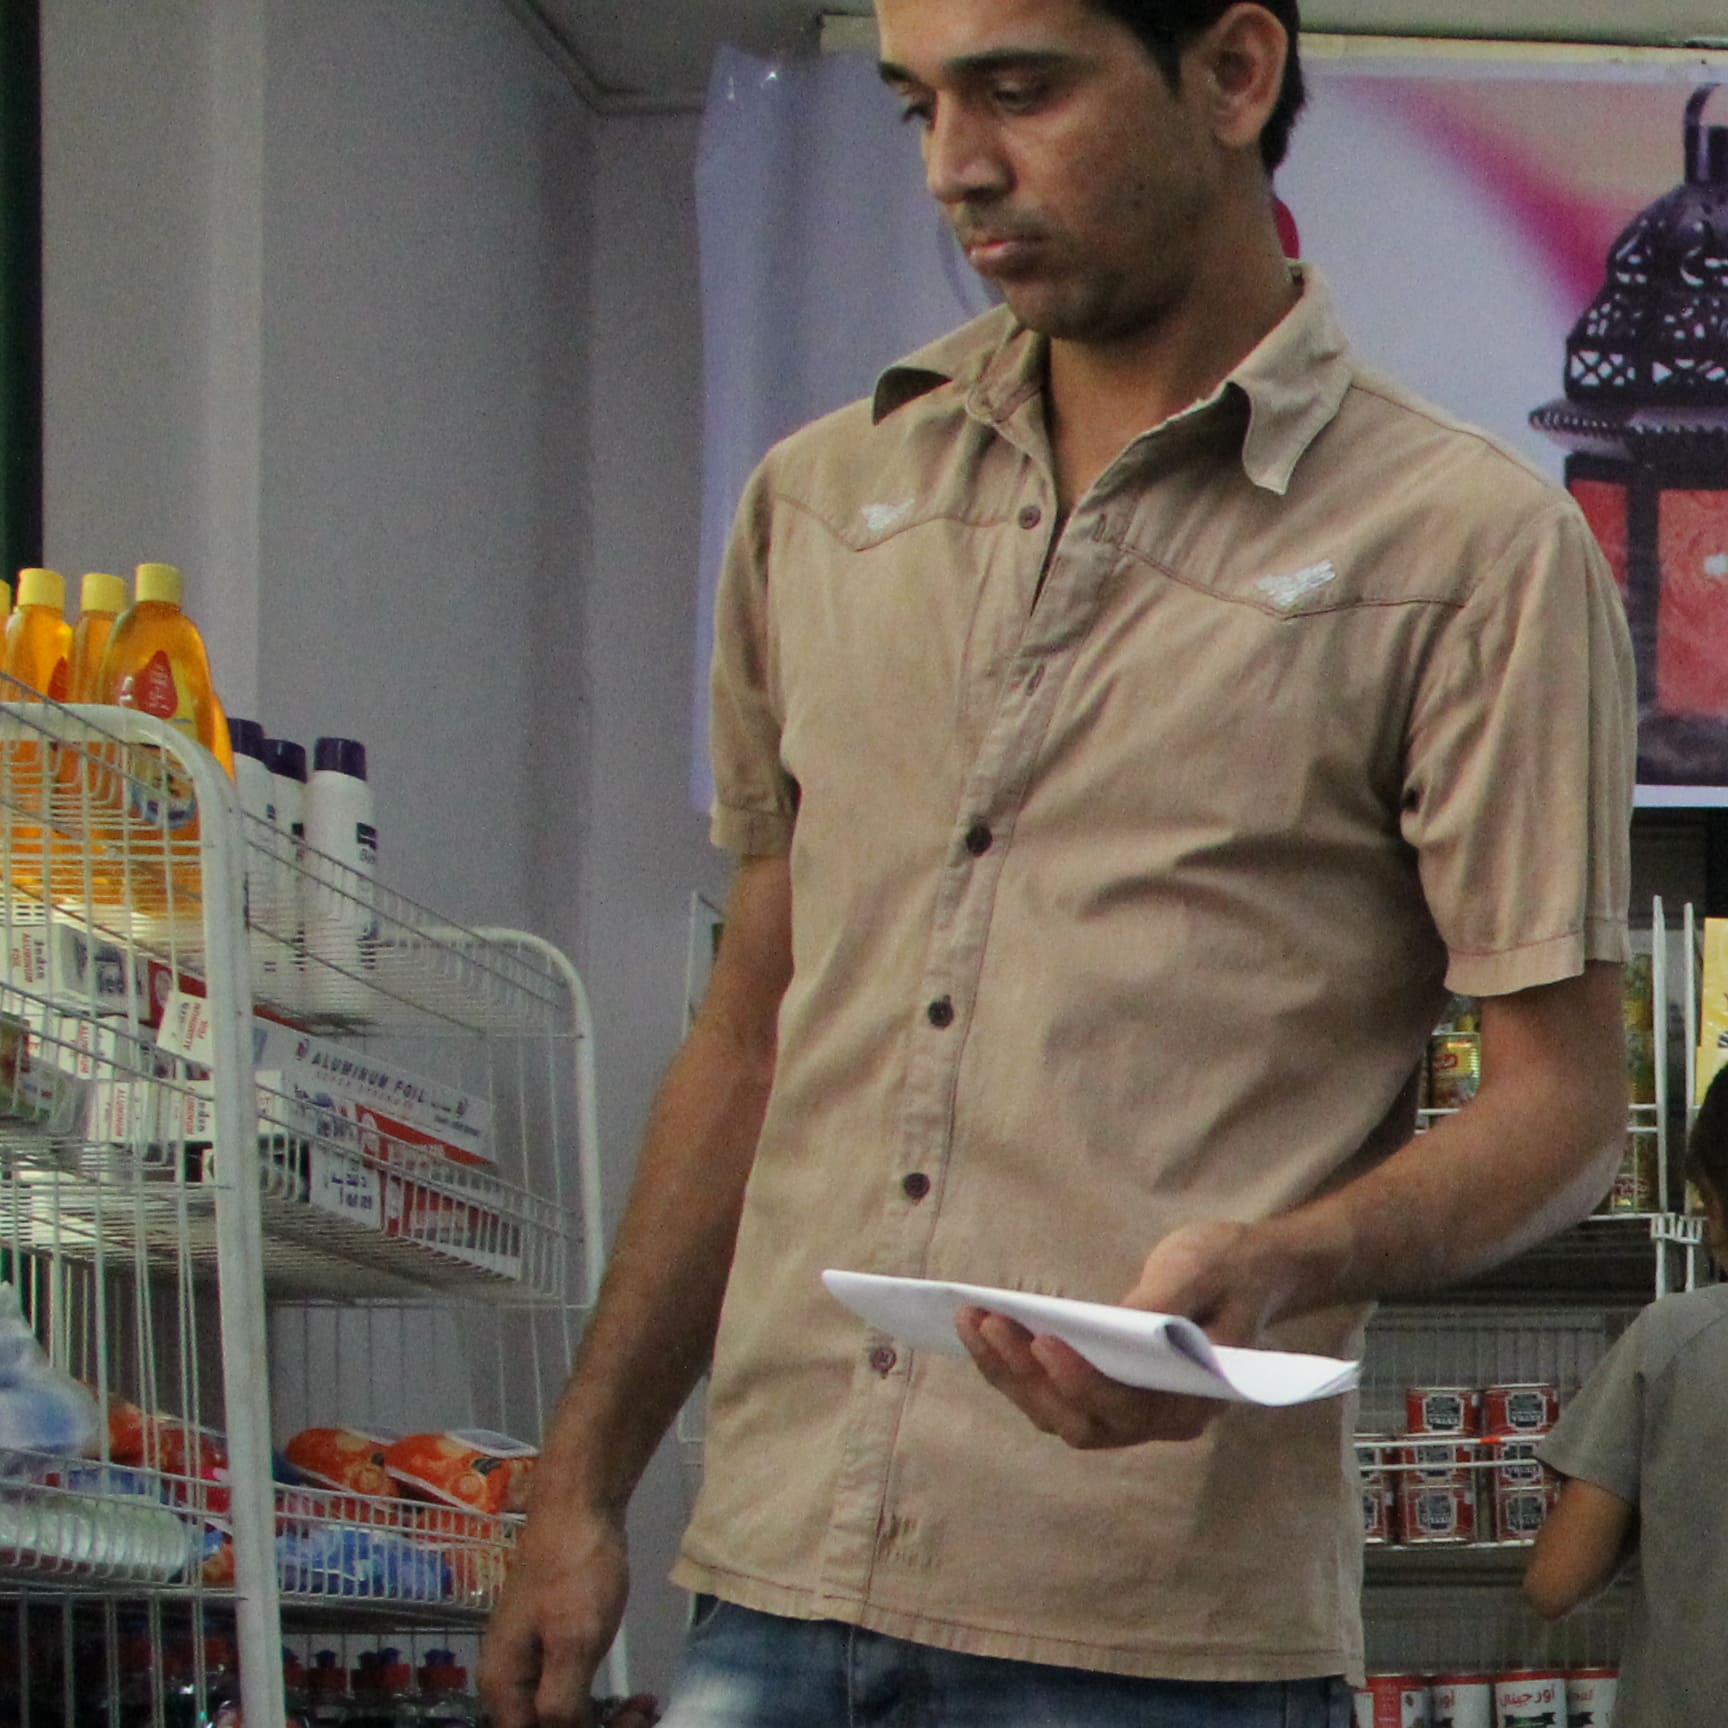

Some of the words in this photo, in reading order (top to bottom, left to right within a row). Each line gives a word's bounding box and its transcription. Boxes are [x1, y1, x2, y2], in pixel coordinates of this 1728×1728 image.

[21, 932, 33, 984] ALUMINUM
[311, 1051, 390, 1092] ALUMINUM
[393, 1079, 426, 1105] FOIL
